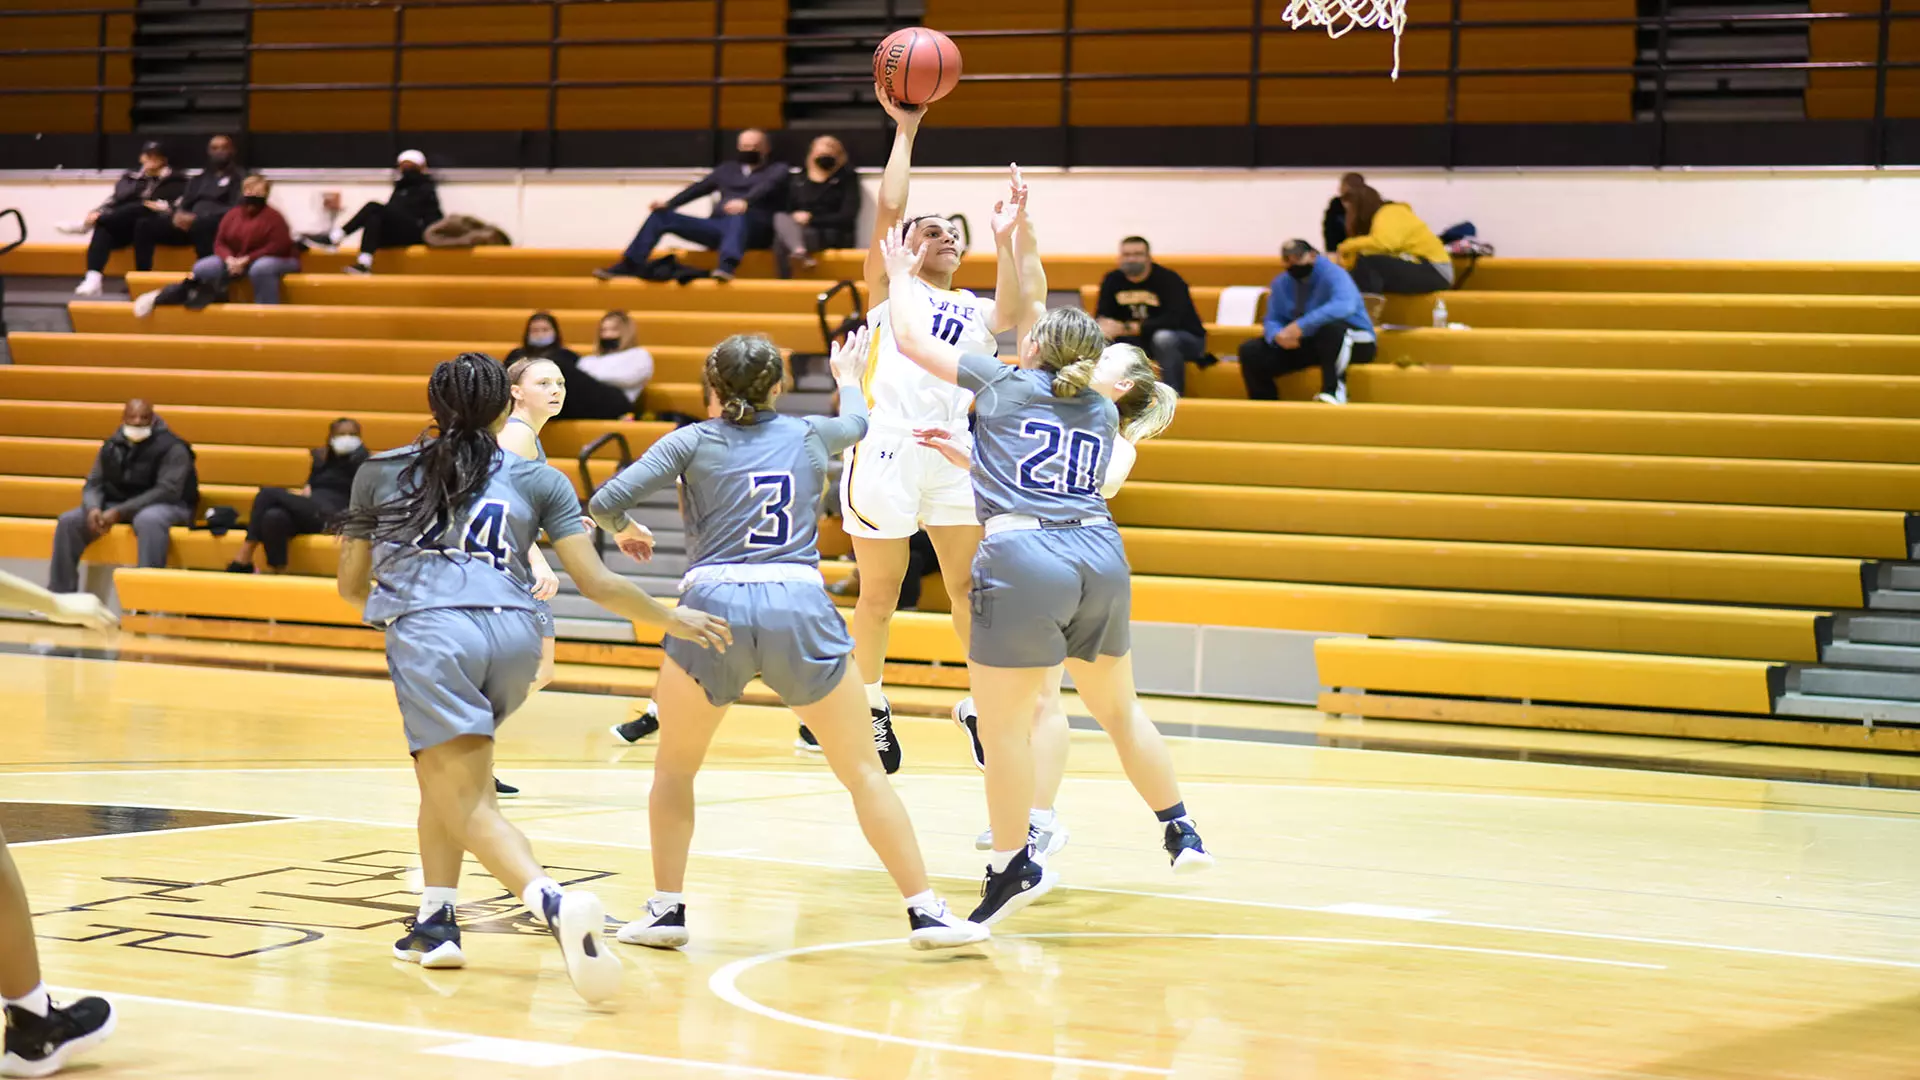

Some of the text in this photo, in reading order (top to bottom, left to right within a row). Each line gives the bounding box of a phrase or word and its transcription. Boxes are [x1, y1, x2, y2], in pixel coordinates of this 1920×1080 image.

[885, 44, 907, 93] Wilson
[930, 313, 964, 346] 10
[1016, 418, 1103, 497] 20
[743, 470, 796, 548] 3
